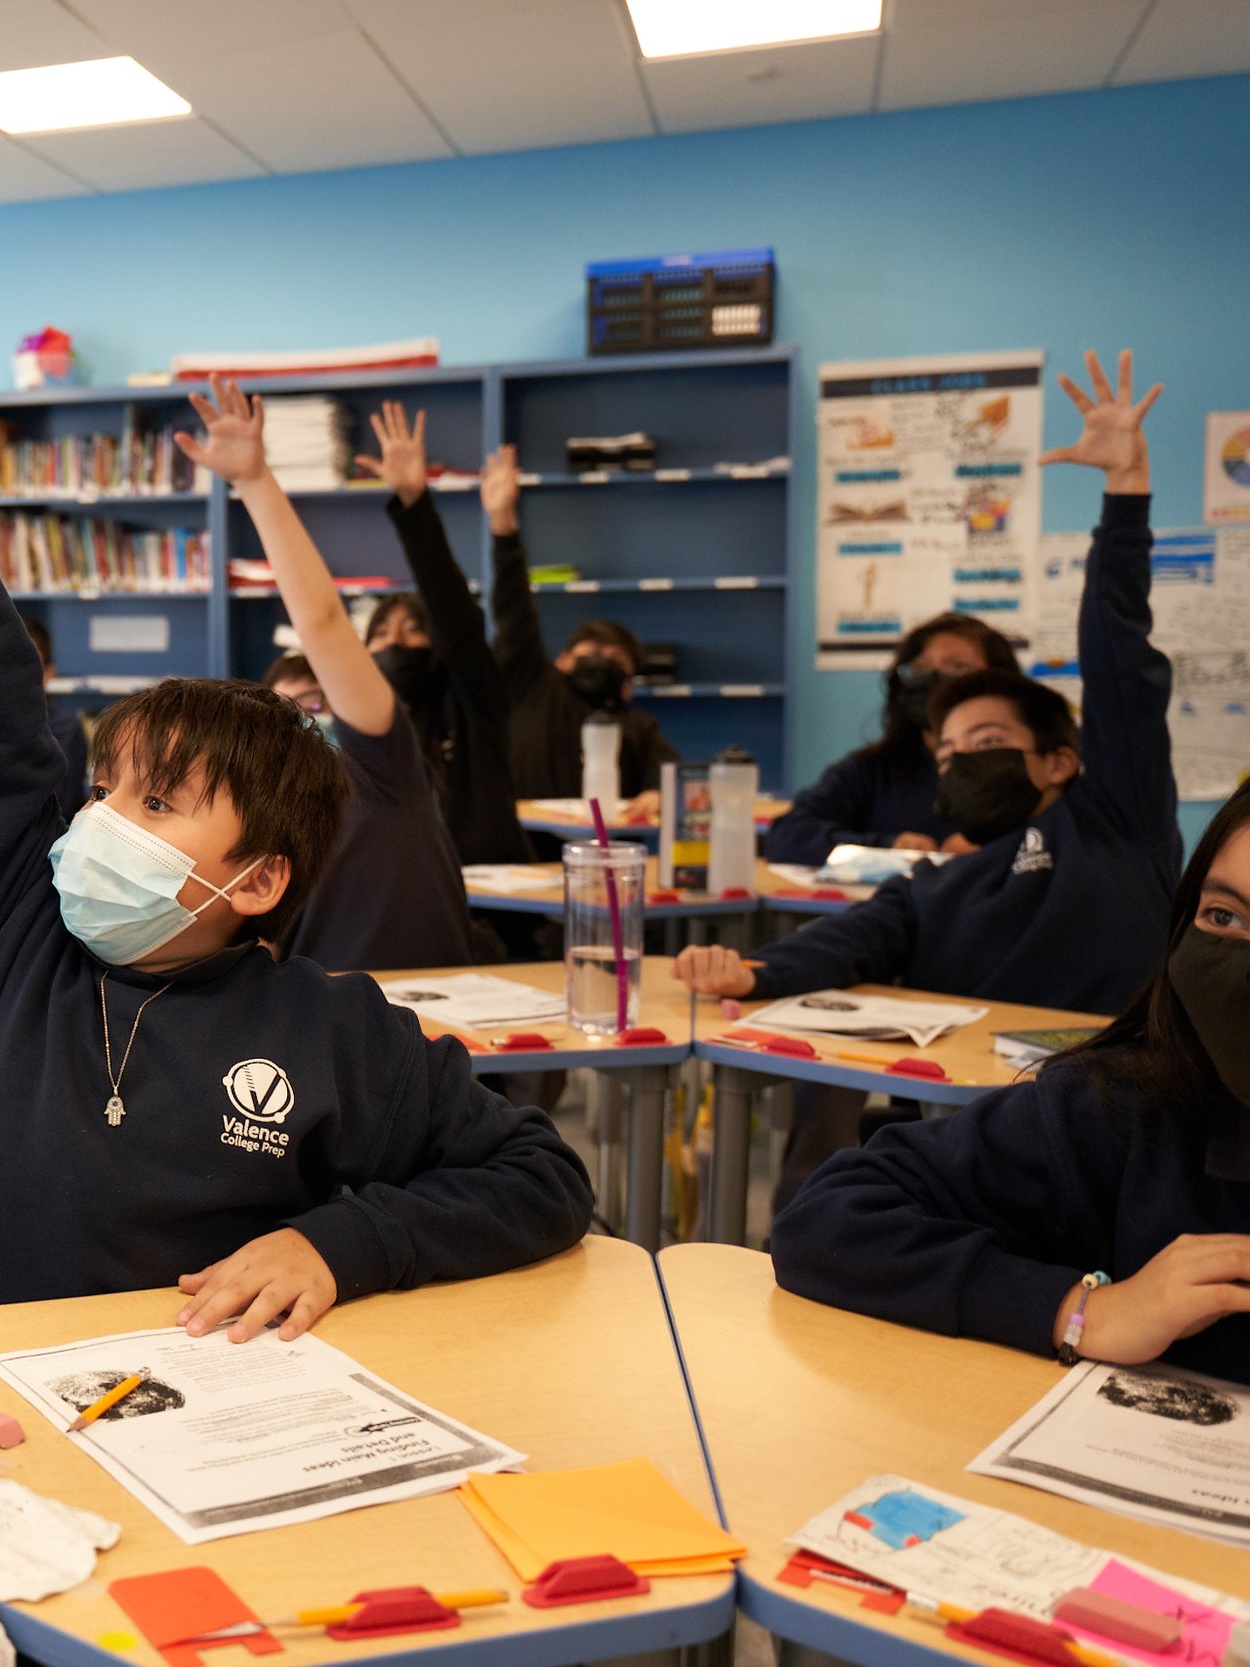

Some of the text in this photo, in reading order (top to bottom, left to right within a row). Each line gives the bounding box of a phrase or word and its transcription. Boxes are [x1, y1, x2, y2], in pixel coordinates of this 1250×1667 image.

[870, 376, 931, 395] CLASS
[223, 1114, 290, 1147] Valence
[220, 1132, 286, 1159] College Prep
[340, 1438, 390, 1454] Details
[375, 1439, 430, 1454] Finding
[341, 1450, 376, 1463] Main
[302, 1460, 341, 1473] Ideas
